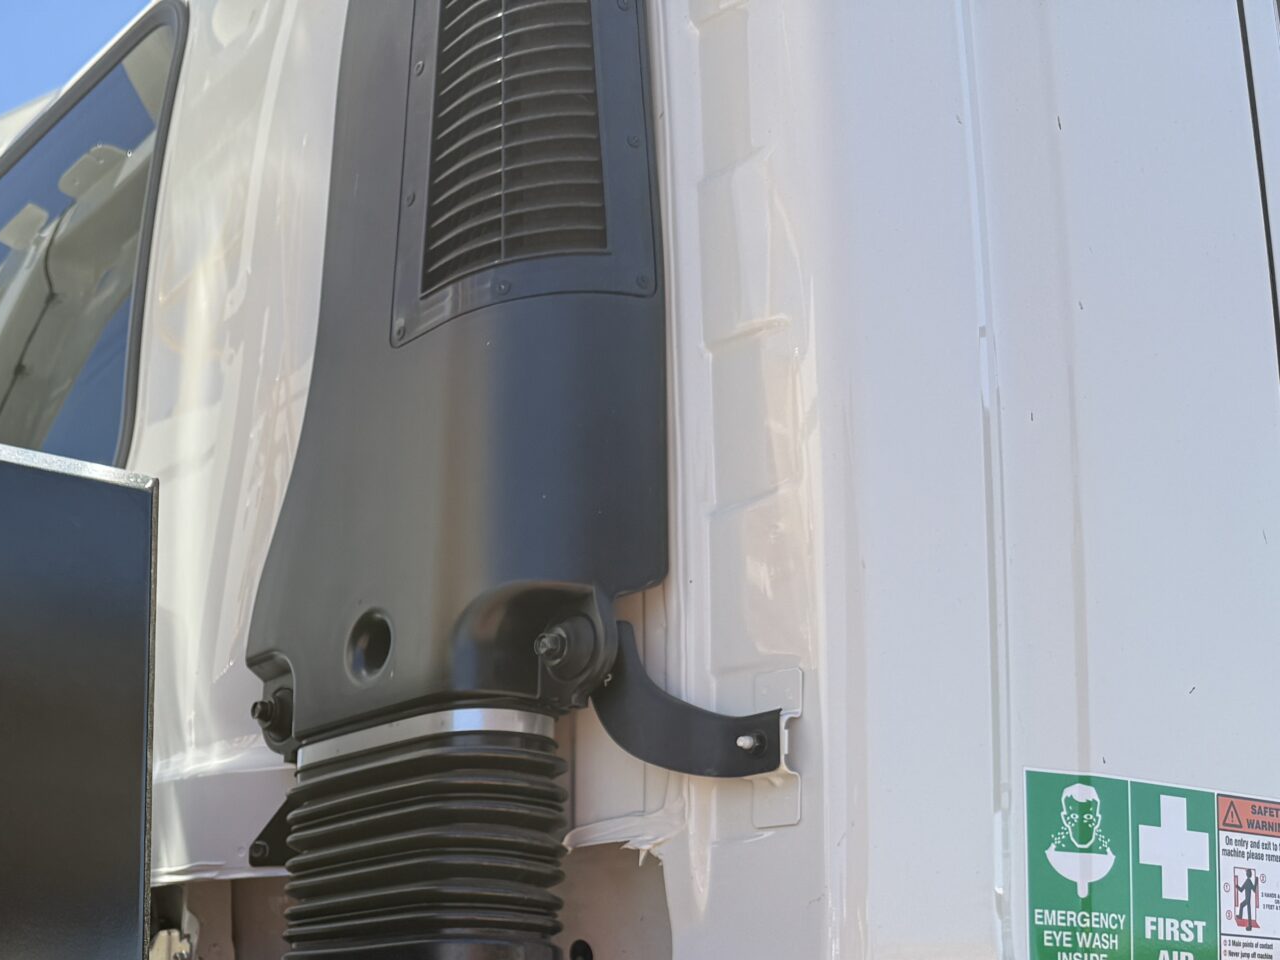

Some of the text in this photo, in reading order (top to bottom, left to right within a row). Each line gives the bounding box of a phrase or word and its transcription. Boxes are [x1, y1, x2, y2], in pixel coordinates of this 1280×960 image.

[1225, 835, 1233, 846] On
[1234, 838, 1249, 849] entry
[1249, 839, 1260, 850] and
[1261, 840, 1271, 851] exit
[1221, 848, 1280, 863] machine please reme
[1034, 908, 1126, 930] EMERGENCY
[1144, 915, 1207, 944] FIRST
[1043, 930, 1119, 950] EYE WASH
